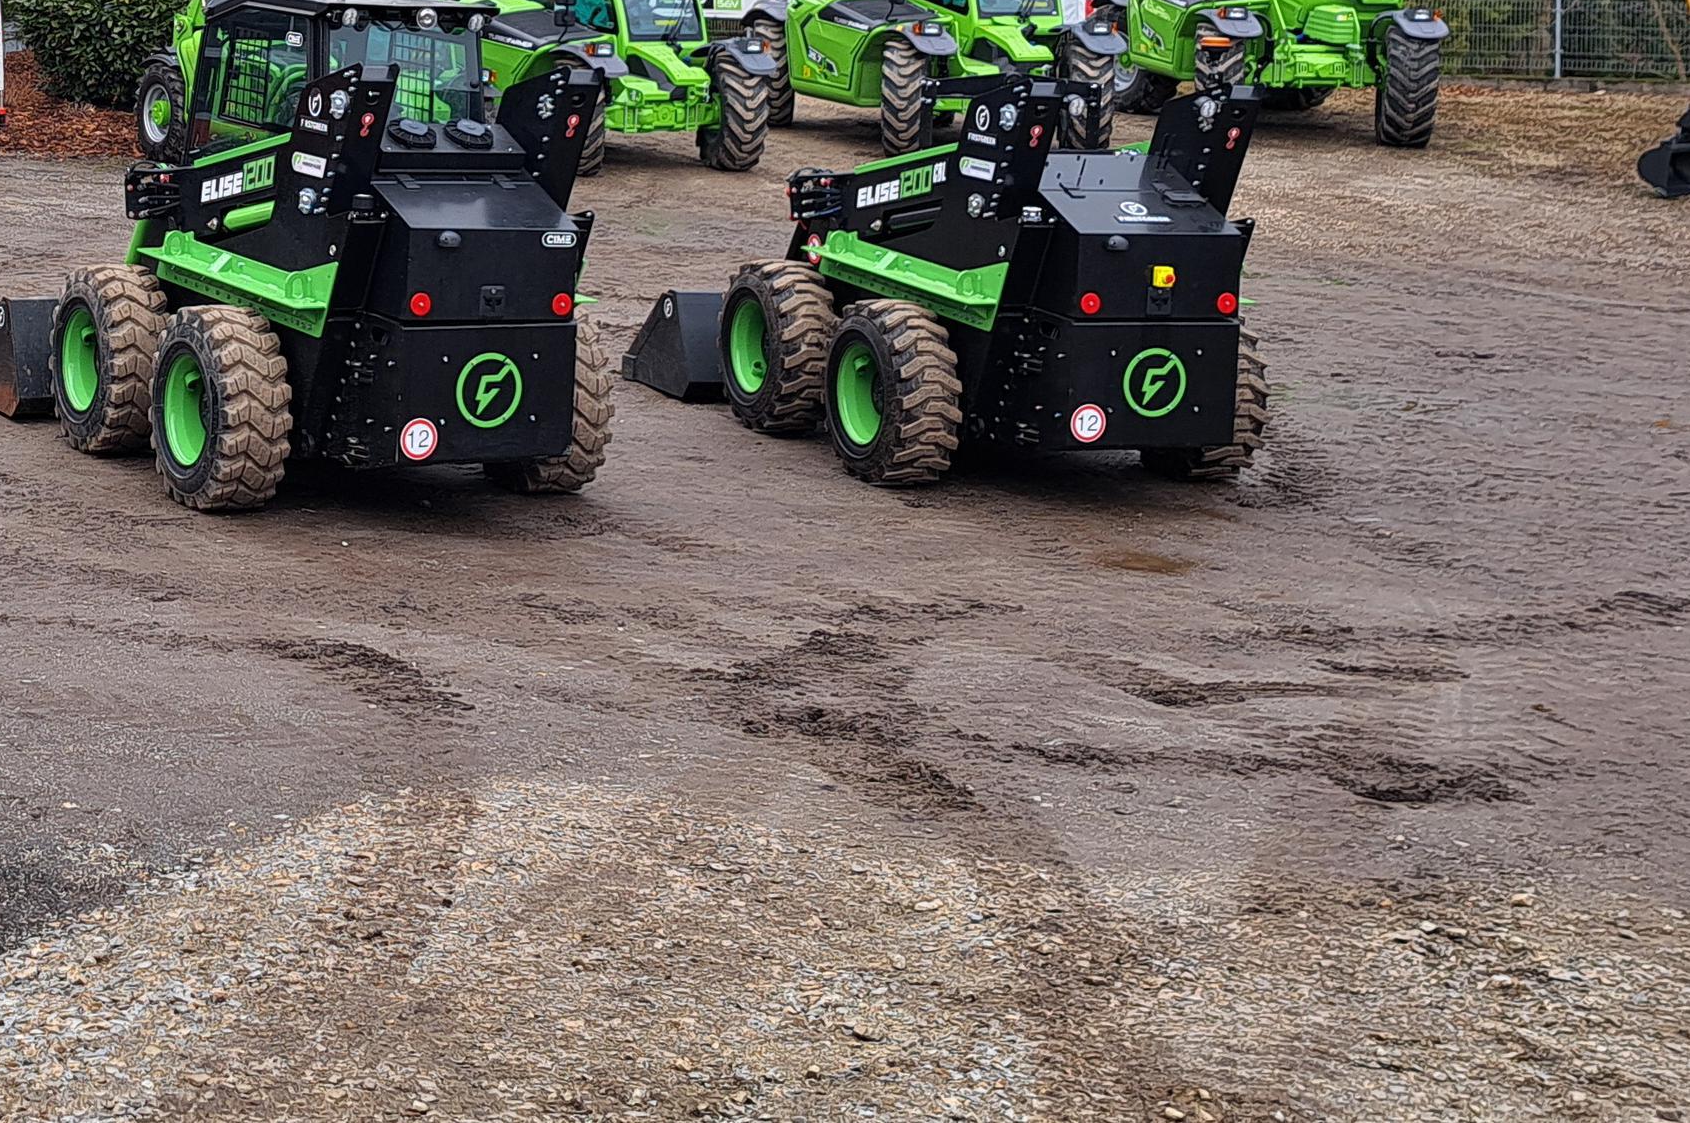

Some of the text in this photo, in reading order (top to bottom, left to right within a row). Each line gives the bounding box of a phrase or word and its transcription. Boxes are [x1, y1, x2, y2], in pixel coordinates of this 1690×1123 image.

[546, 235, 572, 245] CIME
[1078, 414, 1099, 432] 12
[407, 429, 430, 449] 12
